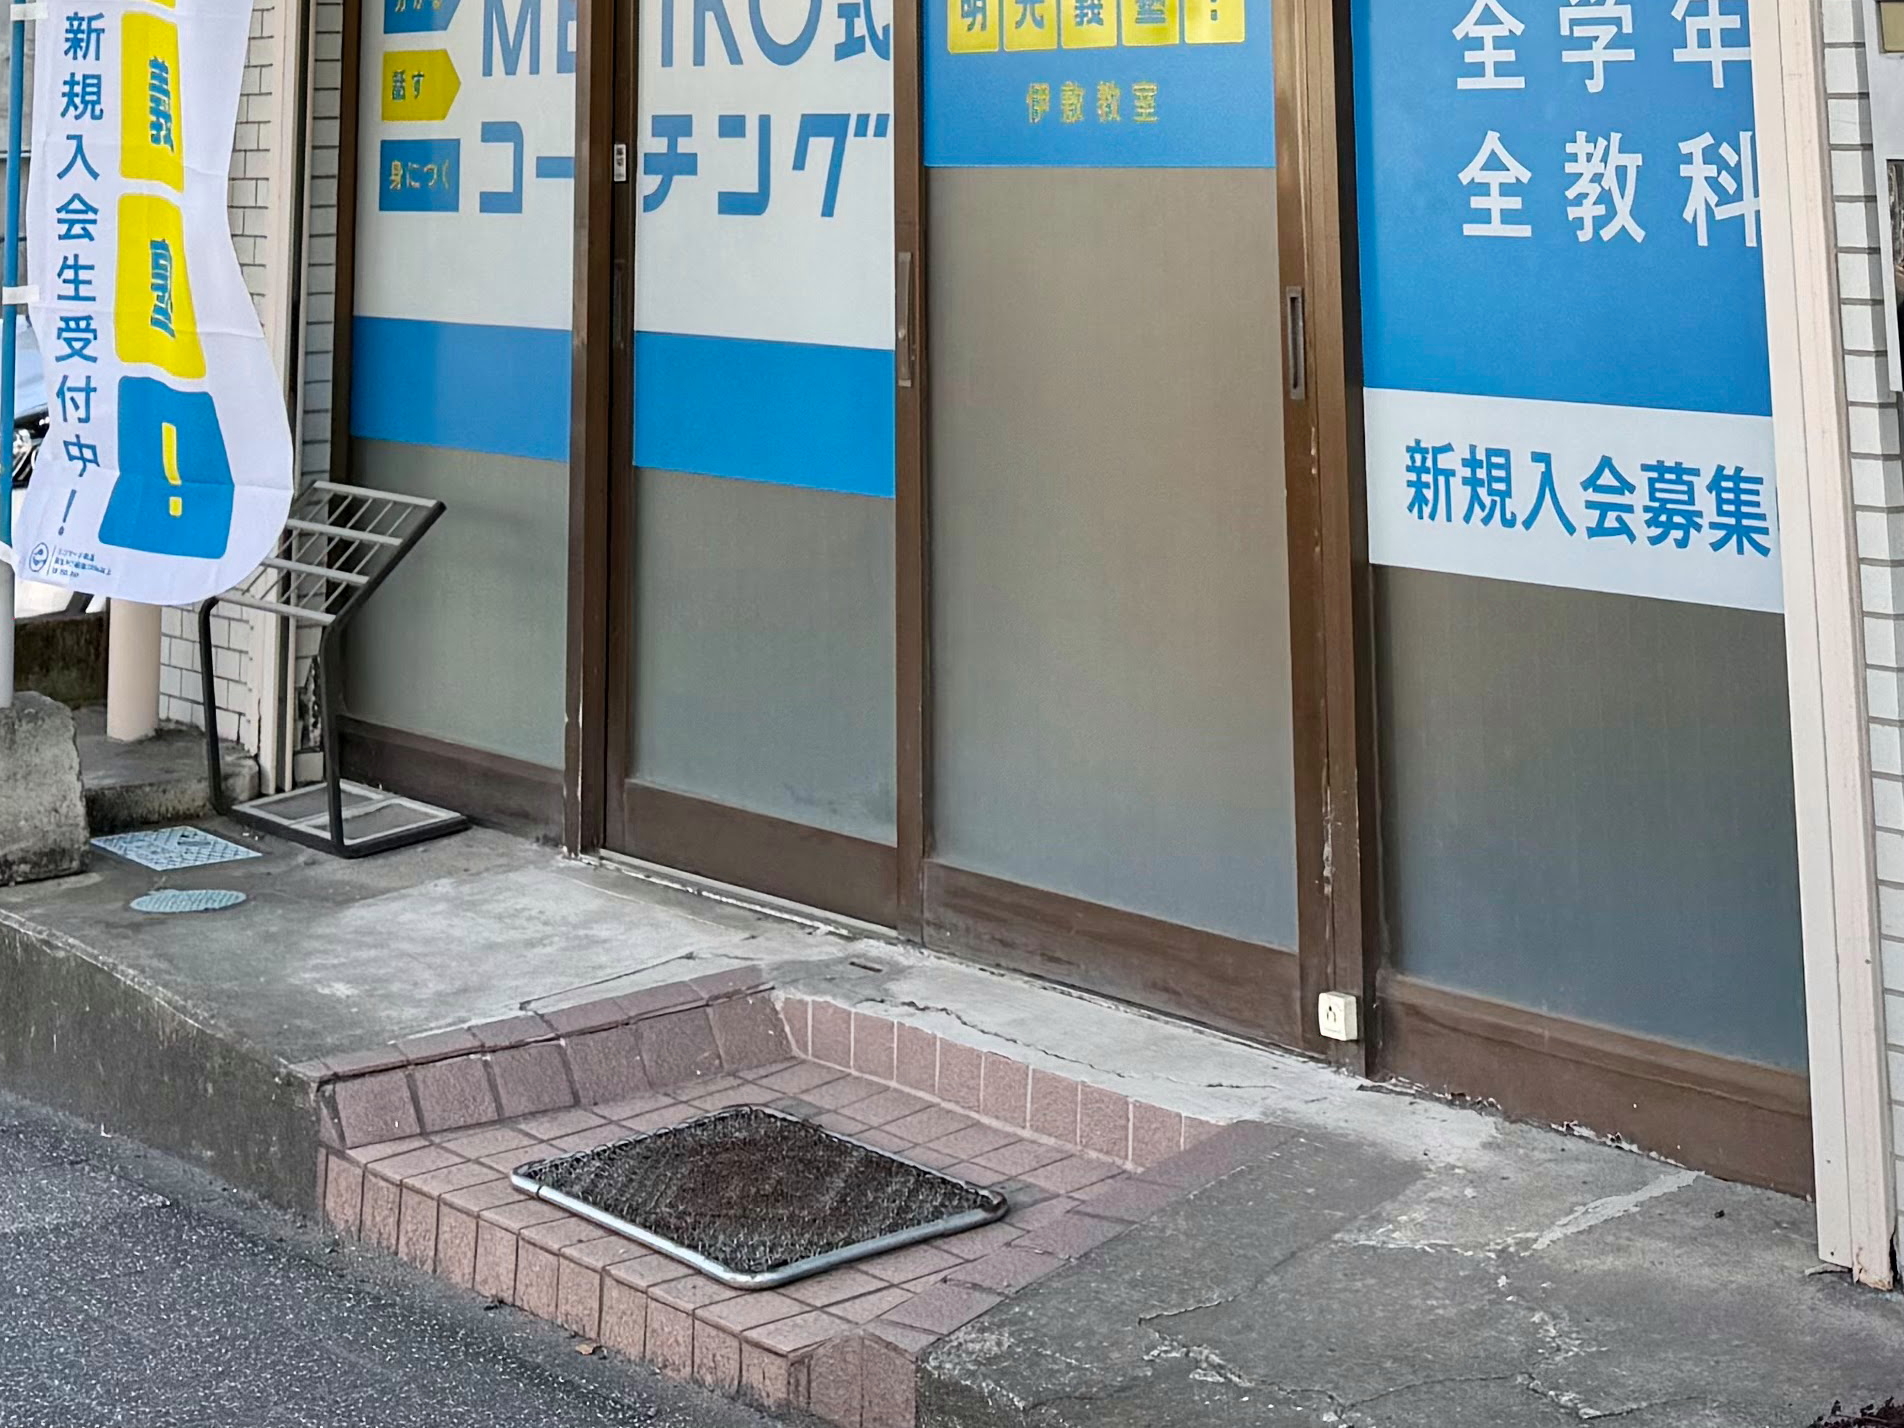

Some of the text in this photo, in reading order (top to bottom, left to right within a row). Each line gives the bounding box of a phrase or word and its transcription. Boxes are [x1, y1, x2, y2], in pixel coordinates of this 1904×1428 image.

[391, 69, 425, 101] 話す
[1026, 81, 1160, 123] 伊敷教室
[390, 159, 449, 190] 身につく
[1457, 129, 1762, 248] 全教科
